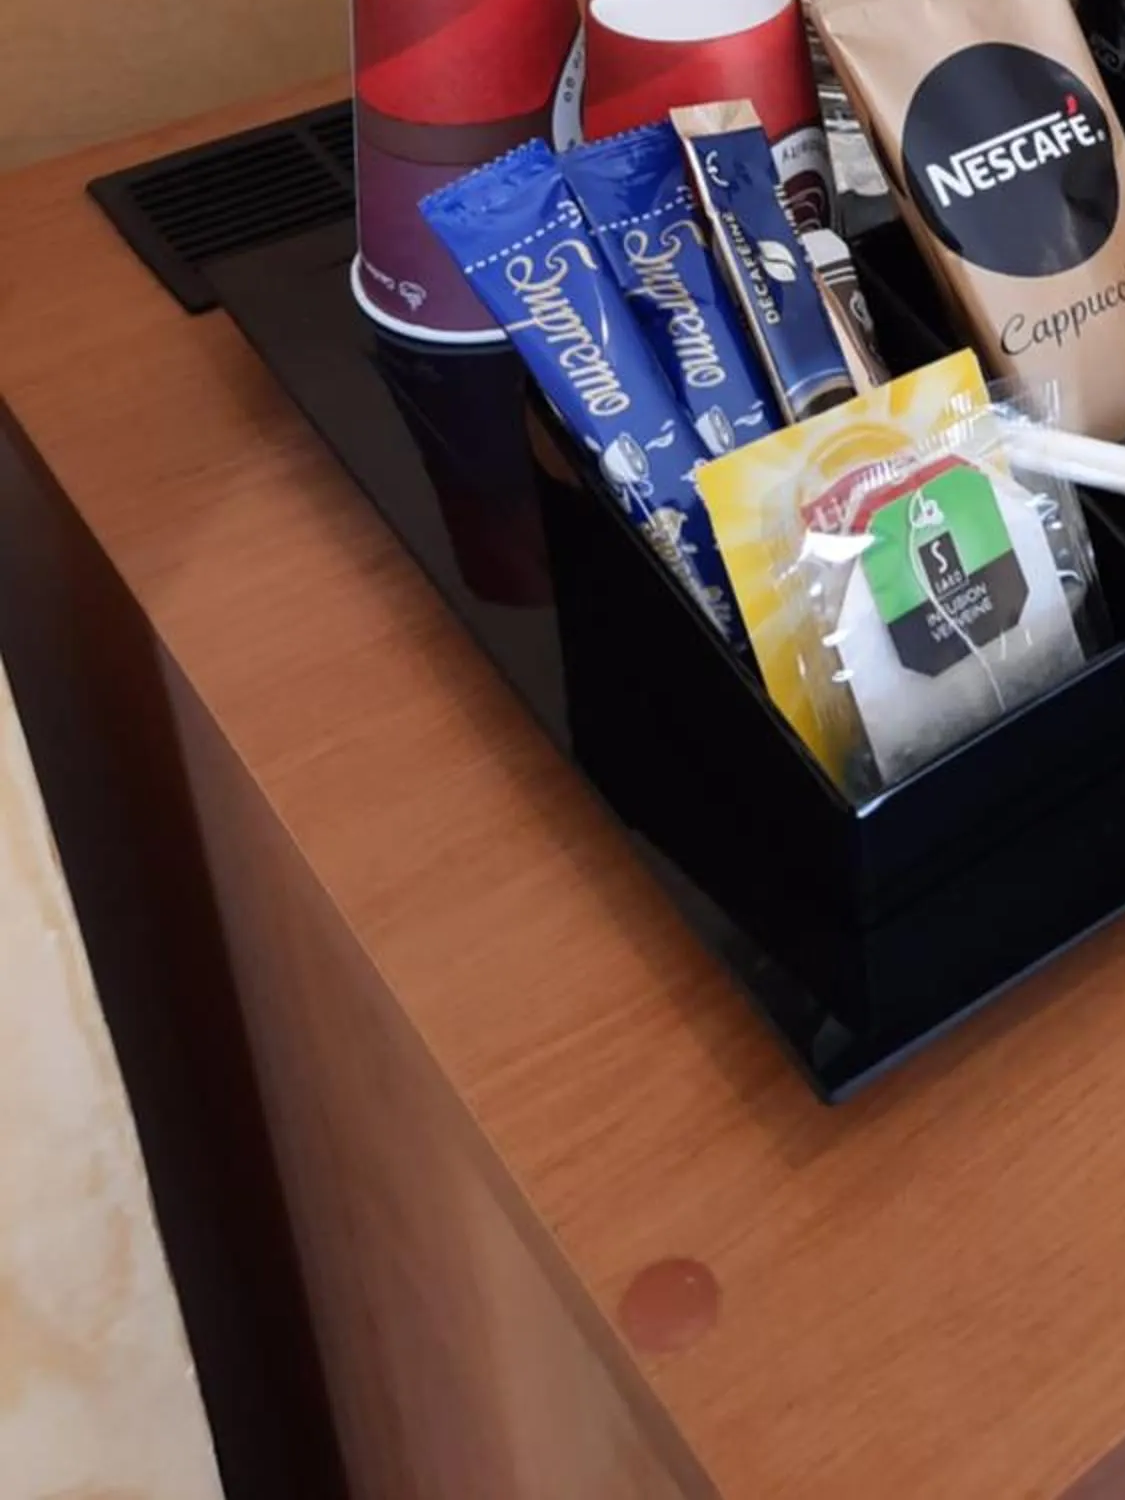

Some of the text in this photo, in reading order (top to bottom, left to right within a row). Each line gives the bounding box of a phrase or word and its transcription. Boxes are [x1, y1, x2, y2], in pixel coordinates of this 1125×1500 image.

[505, 239, 631, 417] Supremo
[622, 219, 726, 388] Supremo
[927, 582, 988, 627] INUSION
[931, 596, 992, 642] VEVEINE
